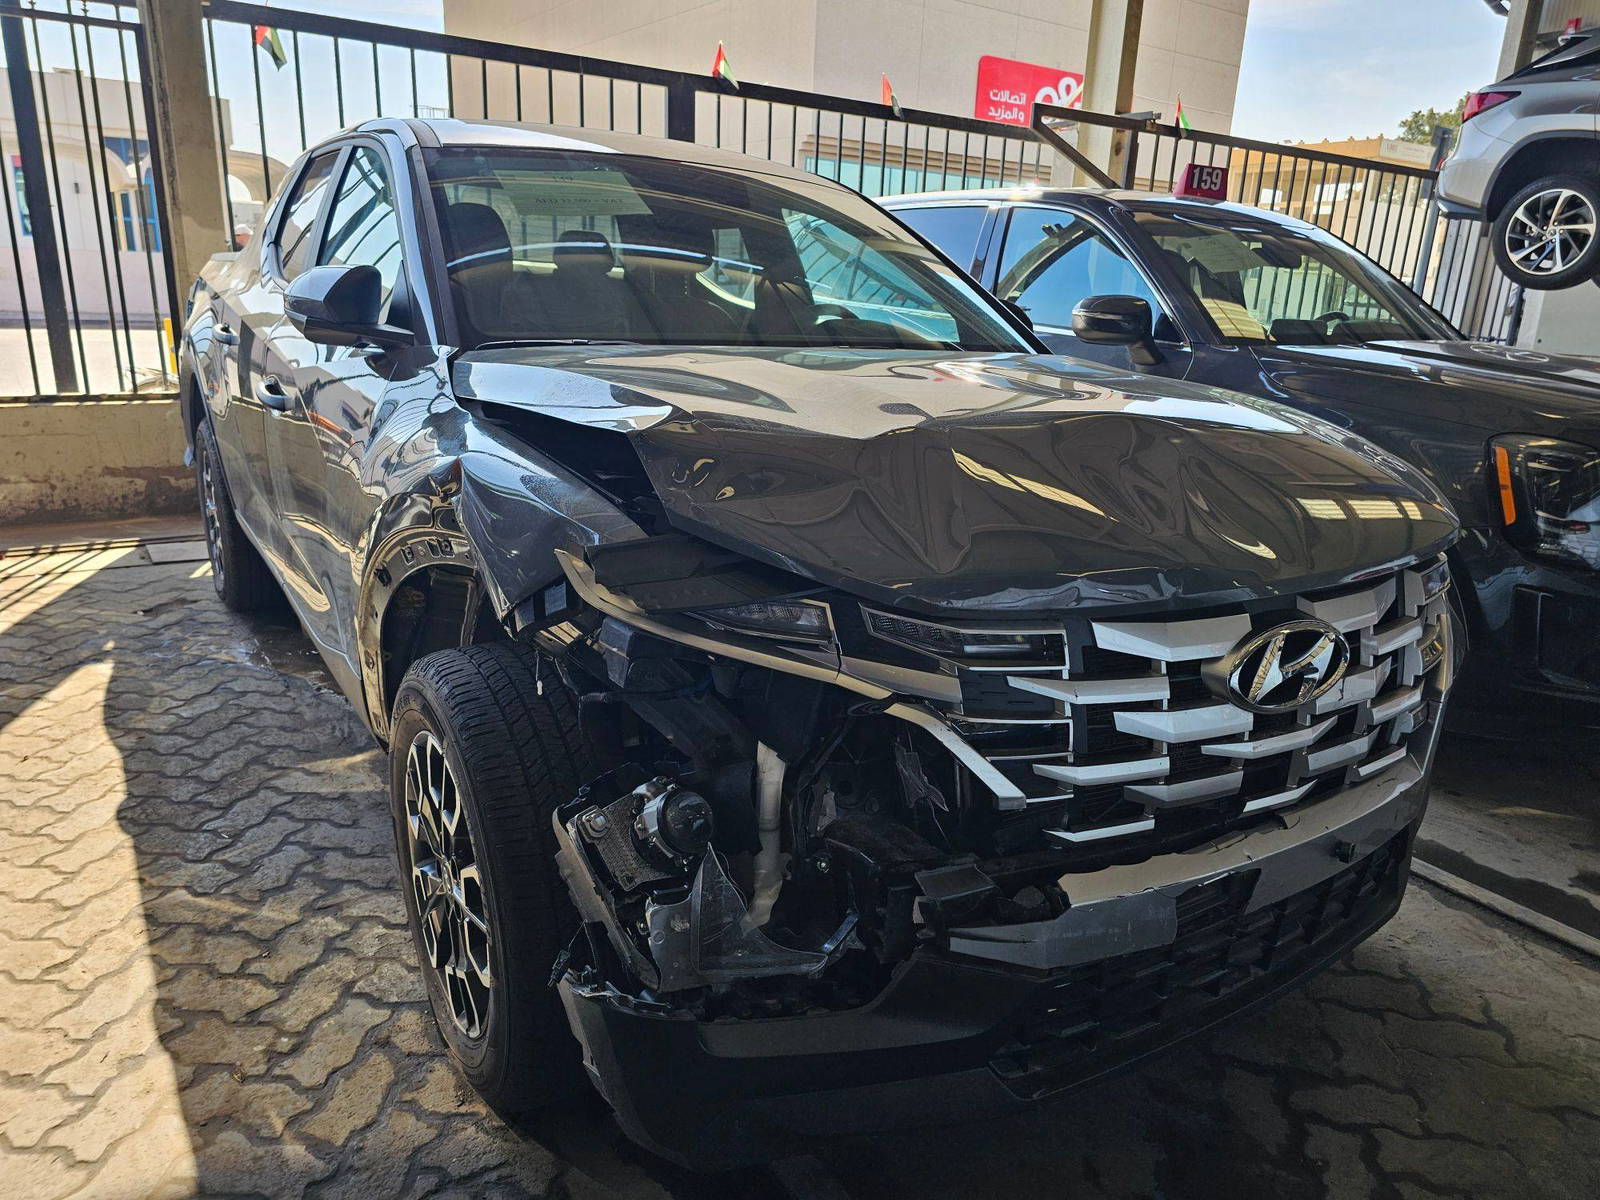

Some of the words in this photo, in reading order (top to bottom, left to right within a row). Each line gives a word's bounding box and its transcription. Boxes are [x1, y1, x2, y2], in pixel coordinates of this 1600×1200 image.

[990, 89, 1026, 105] اتصالات
[989, 105, 1024, 122] والمزيد
[1193, 167, 1222, 190] 159
